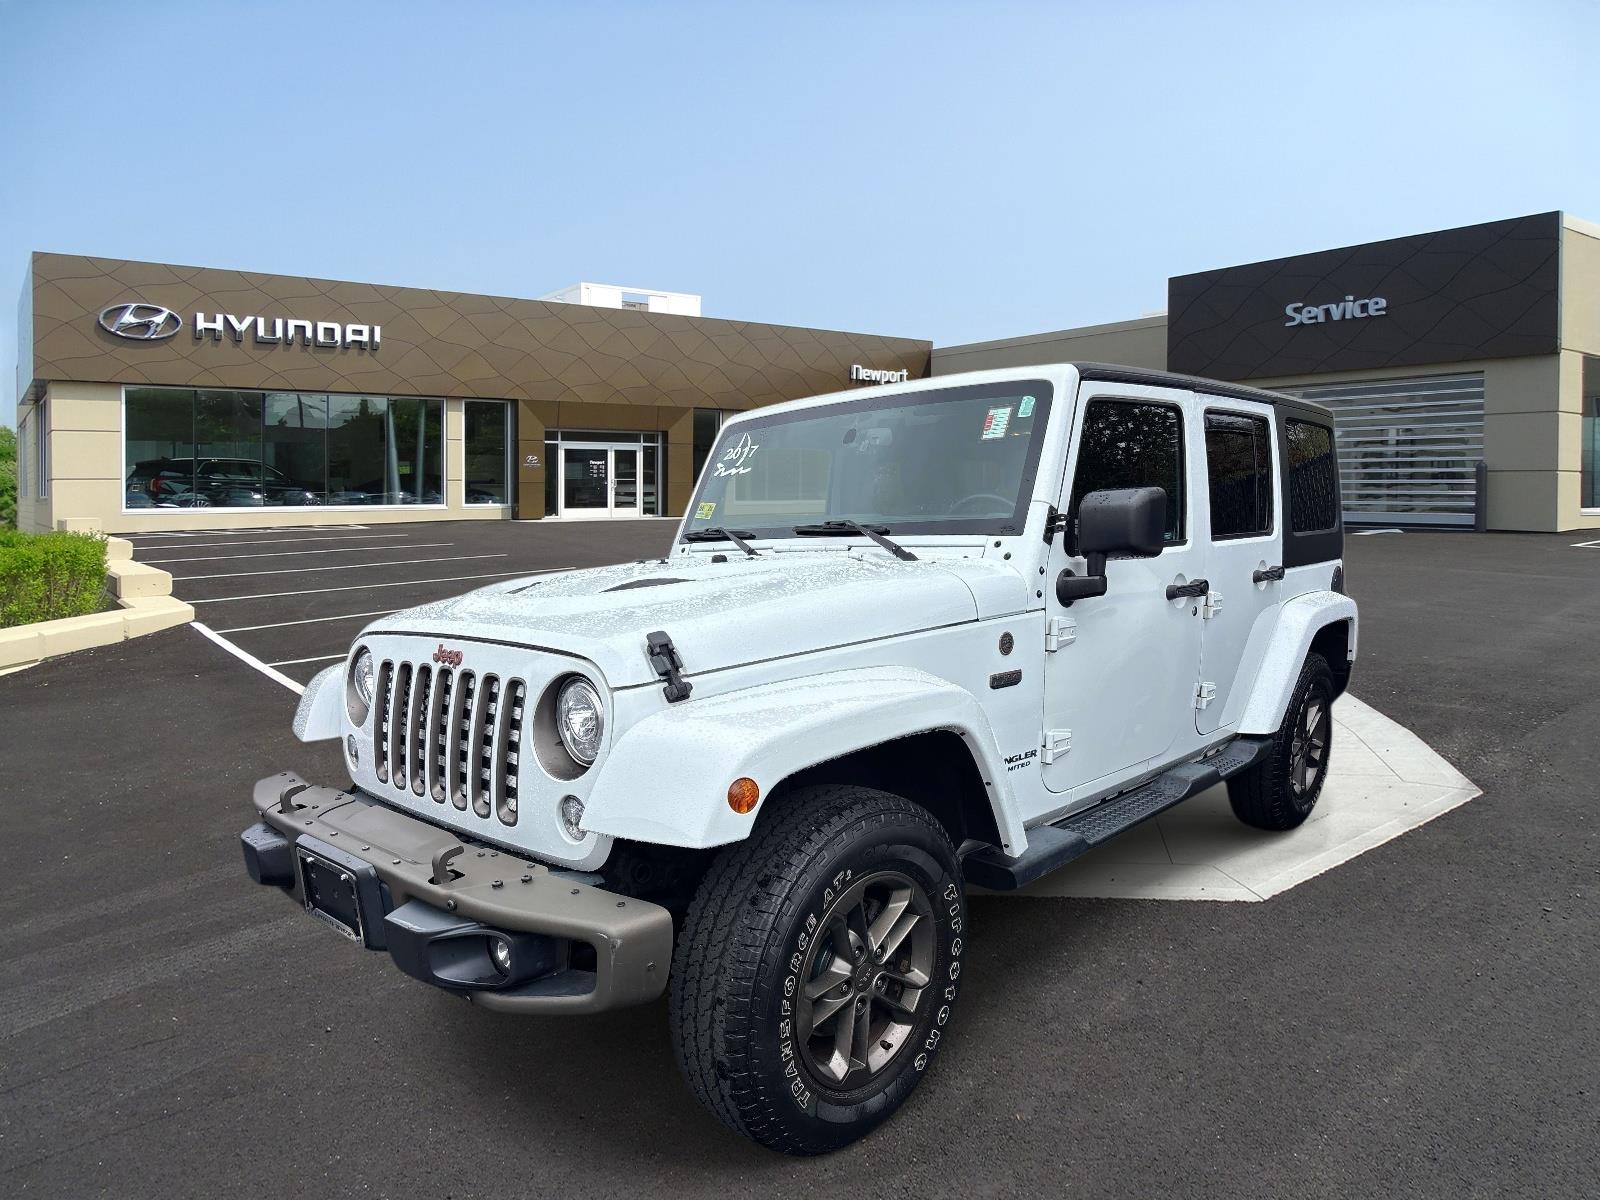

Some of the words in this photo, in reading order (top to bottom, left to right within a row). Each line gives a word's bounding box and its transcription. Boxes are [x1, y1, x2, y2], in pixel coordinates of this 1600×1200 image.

[1284, 295, 1387, 327] Service
[194, 312, 382, 350] HYUNDAI
[850, 364, 909, 385] Newport
[433, 644, 463, 669] Jeep
[779, 912, 818, 1110] TRANSFORCE
